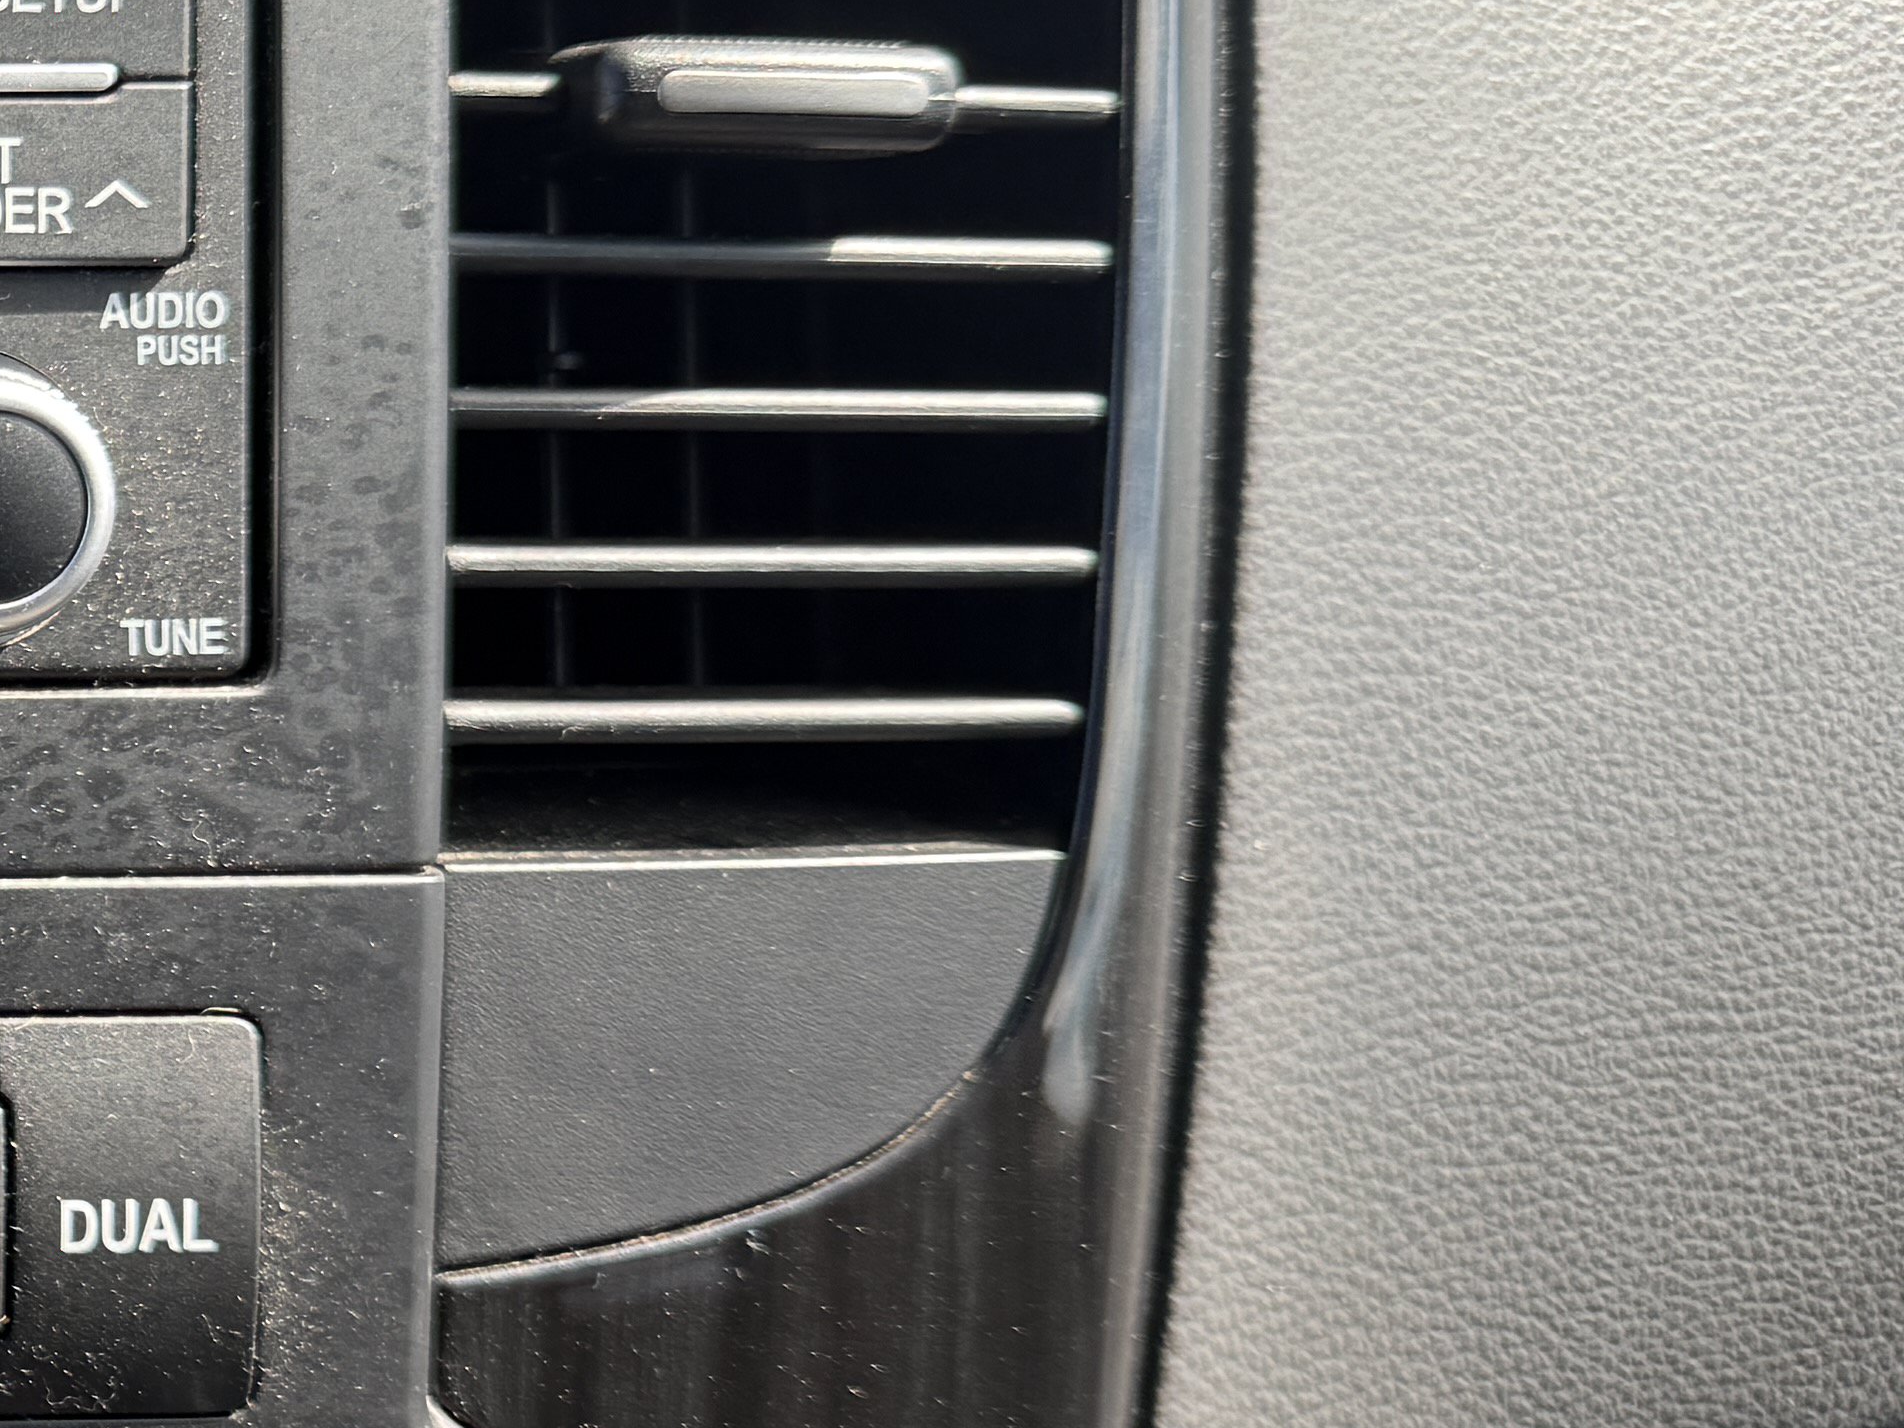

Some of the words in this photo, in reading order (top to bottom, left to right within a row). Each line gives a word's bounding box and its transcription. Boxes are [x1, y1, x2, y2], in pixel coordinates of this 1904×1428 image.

[100, 291, 230, 330] AUDIO
[136, 333, 228, 365] PUSH
[120, 617, 230, 656] TUNE
[58, 1197, 219, 1254] DUAL
